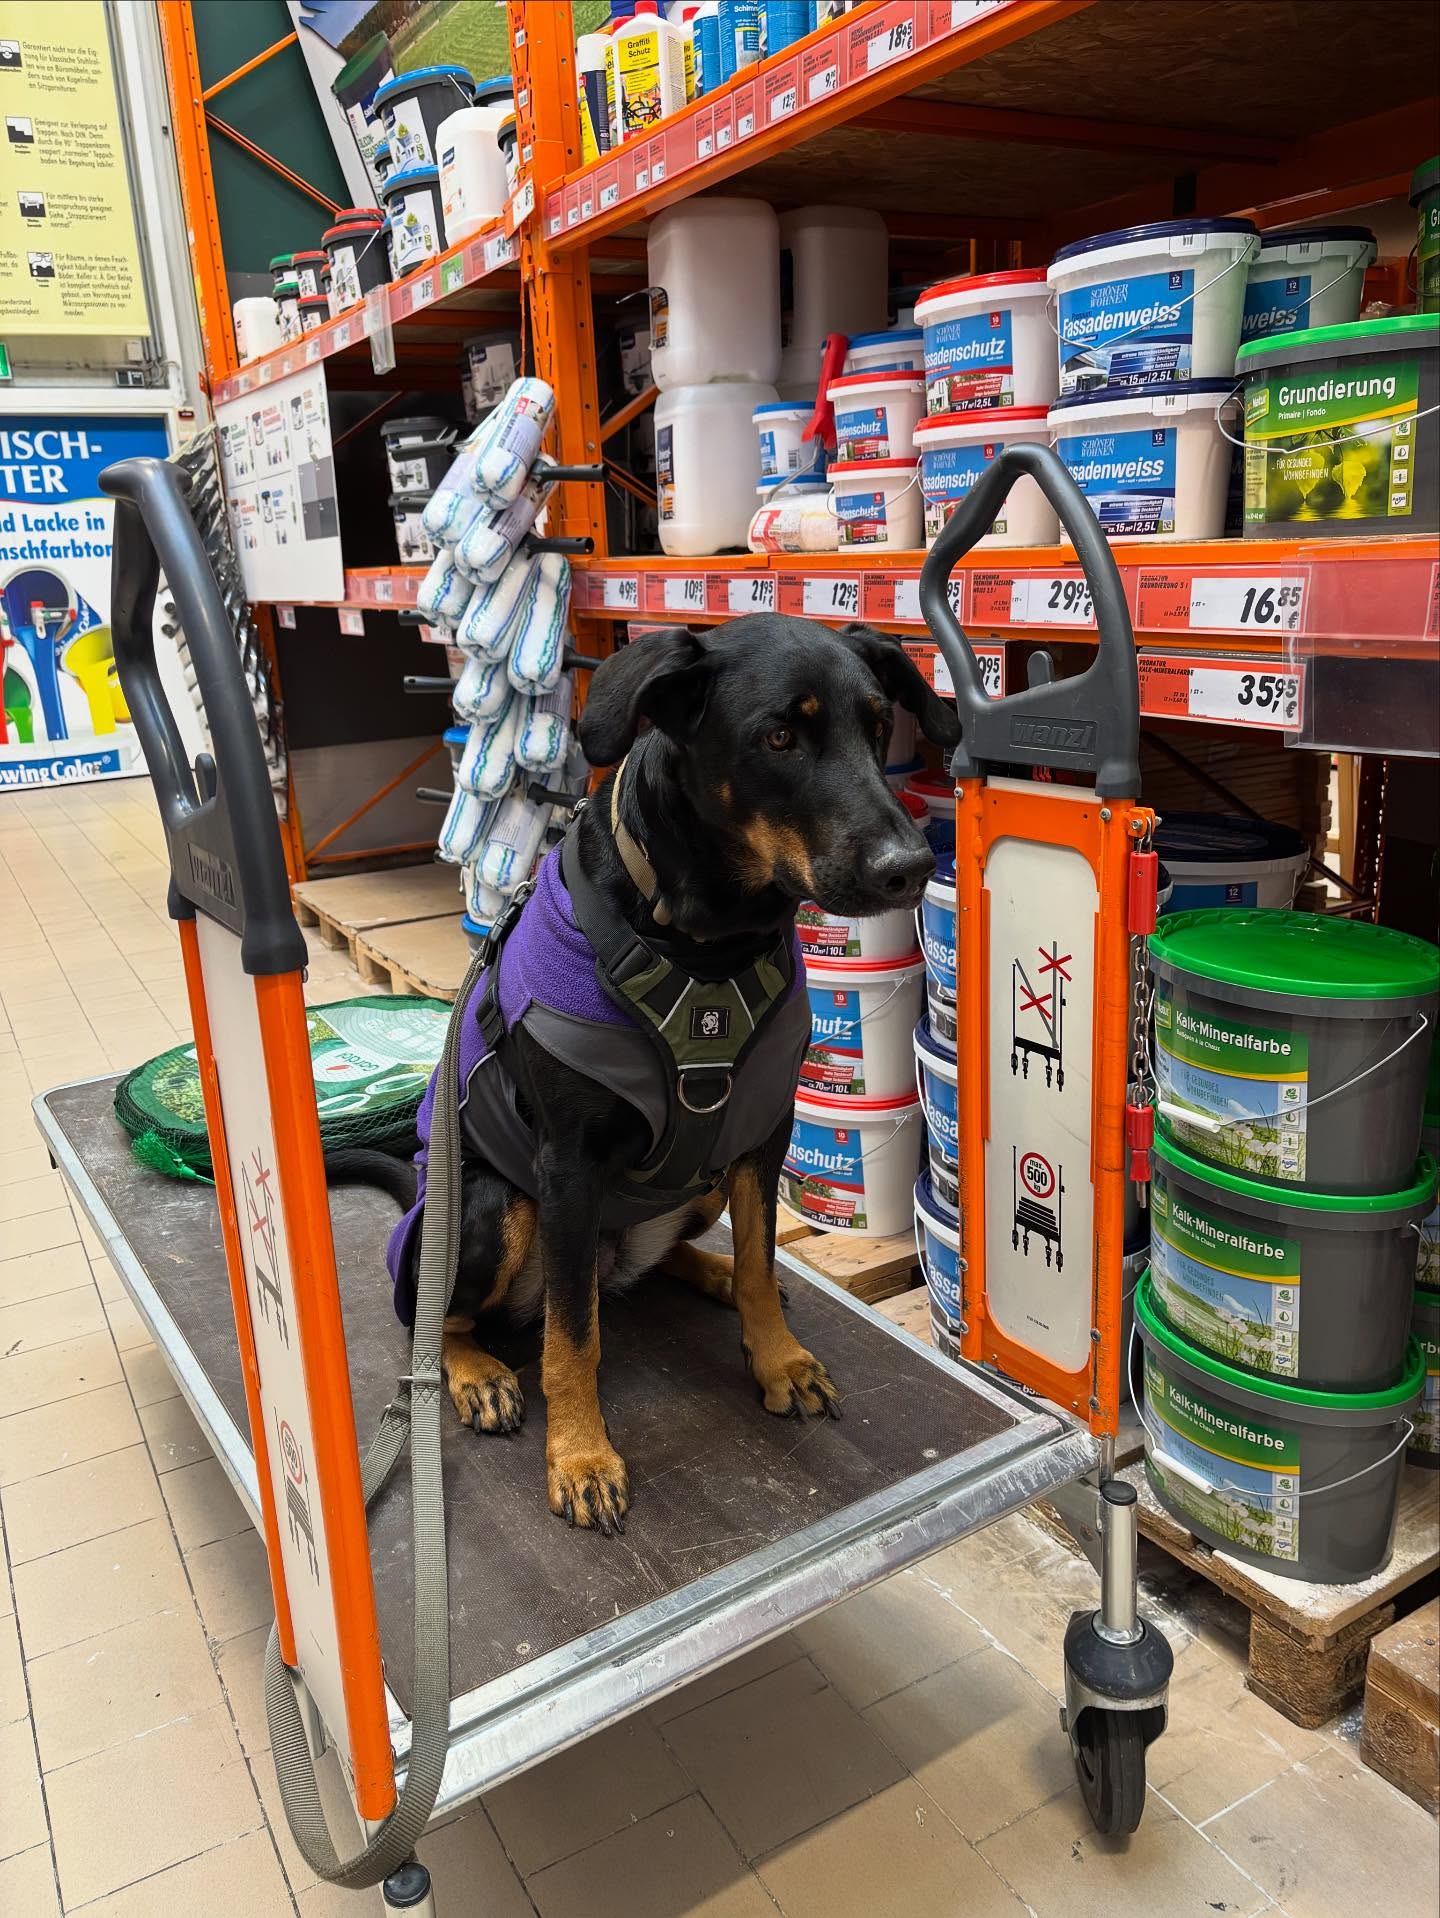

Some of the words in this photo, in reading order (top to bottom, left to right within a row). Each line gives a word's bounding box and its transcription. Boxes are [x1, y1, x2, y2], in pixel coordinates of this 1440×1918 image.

[627, 38, 650, 52] Graffiti
[628, 47, 651, 59] Schutz
[1172, 275, 1180, 284] 12
[1091, 284, 1128, 299] SCHÖNER
[1090, 294, 1128, 308] WOHNEN
[1063, 301, 1182, 338] Fassadenweiss
[924, 337, 1006, 369] ssadenschutz
[1128, 374, 1139, 385] 15
[1278, 377, 1396, 406] Grundierung
[1278, 411, 1301, 420] Primaire
[1307, 408, 1326, 417] Fondo
[1081, 438, 1115, 449] SCHÖNER
[1155, 433, 1163, 441] 12
[0, 430, 103, 460] ISCH-
[1081, 447, 1114, 457] WOHNEN
[1067, 456, 1165, 482] ssadenweiss
[22, 511, 80, 532] Lacke
[84, 510, 105, 531] in
[1116, 522, 1125, 533] 15
[684, 580, 703, 603] 10,95
[751, 580, 773, 604] 21,95
[832, 582, 858, 610] 12,95
[852, 600, 857, 613] €
[1048, 580, 1091, 613] 29,95
[1083, 602, 1092, 617] €
[1288, 611, 1300, 629] €
[1139, 667, 1194, 676] KALK-MINERALFARBE
[994, 675, 1000, 689] €
[1237, 674, 1298, 714] 35,95
[1285, 701, 1297, 718] €
[1228, 888, 1238, 896] 12
[810, 944, 818, 954] 70
[830, 946, 838, 955] 10
[839, 946, 845, 955] L
[836, 993, 844, 1001] 10
[1176, 1011, 1292, 1056] Kalk-Mineralfarbe
[815, 1079, 824, 1089] 70
[835, 1082, 844, 1093] 10
[844, 1084, 850, 1094] L
[837, 1131, 846, 1139] 10
[1030, 1159, 1045, 1170] max.
[1027, 1165, 1047, 1186] 500
[818, 1214, 826, 1222] 70
[837, 1216, 846, 1226] 10
[1172, 1203, 1285, 1260] Kalk-Mineralfarbe
[1169, 1385, 1286, 1451] Kalk-Mineralfarbe
